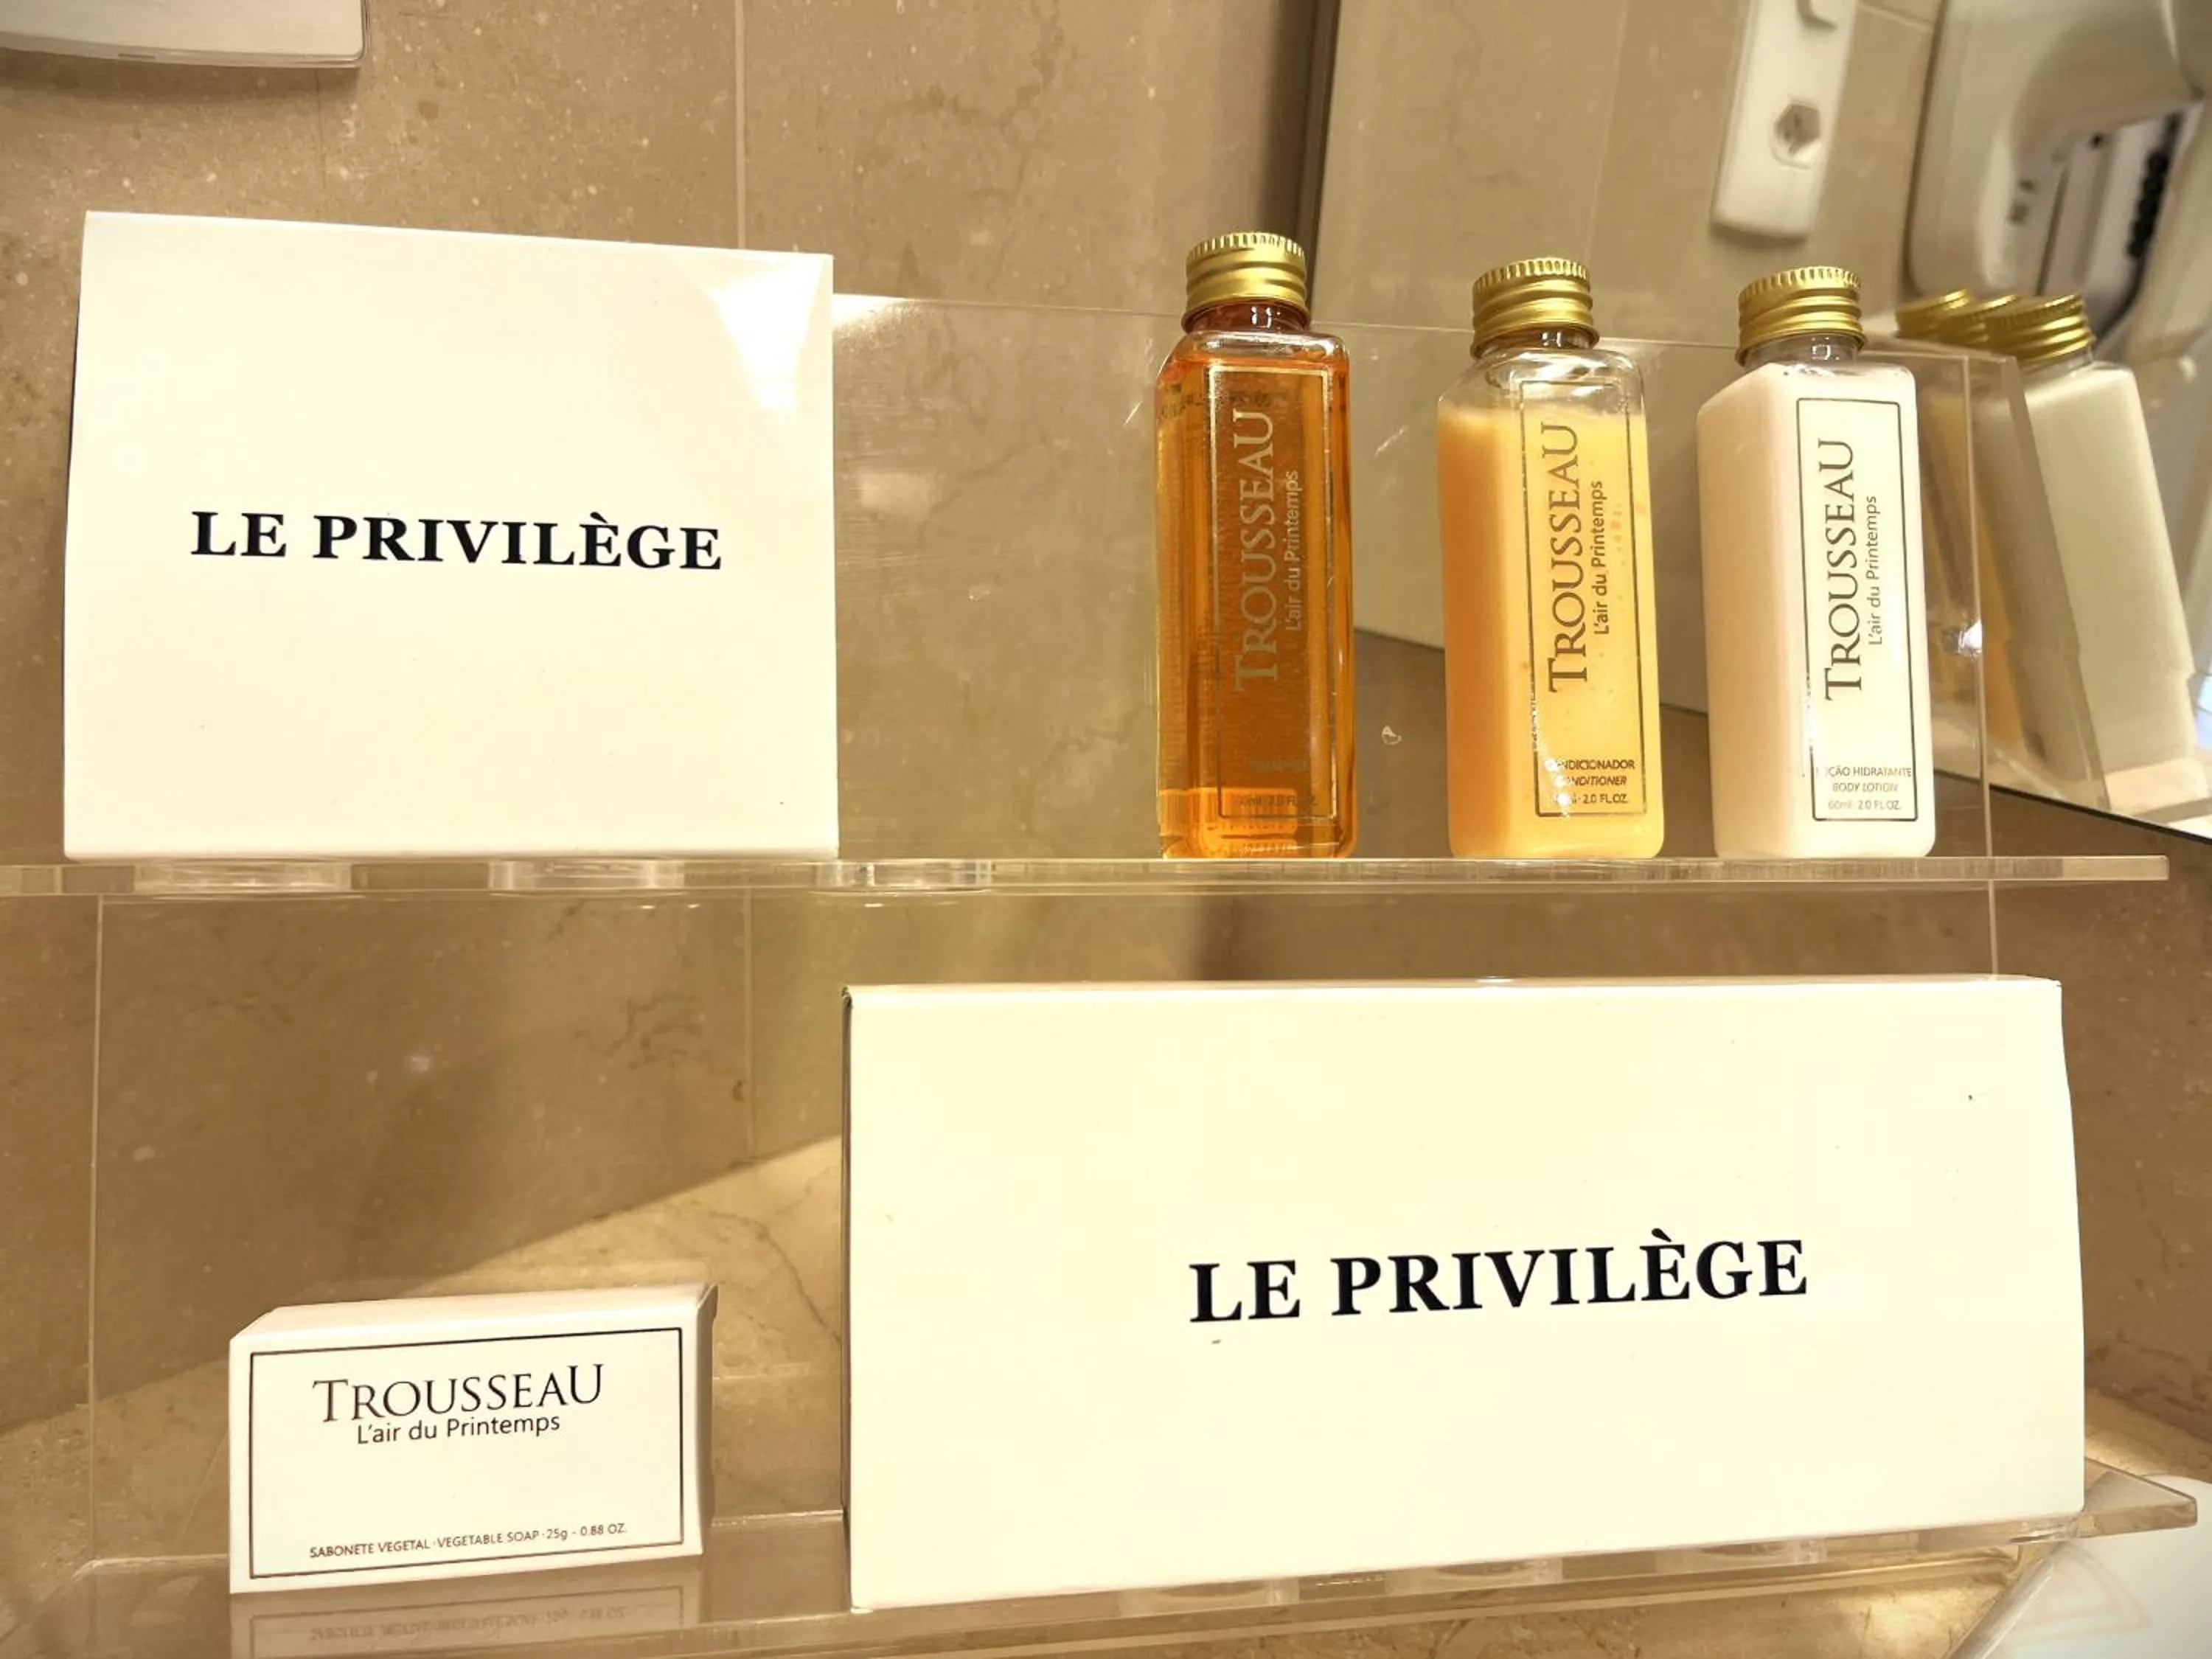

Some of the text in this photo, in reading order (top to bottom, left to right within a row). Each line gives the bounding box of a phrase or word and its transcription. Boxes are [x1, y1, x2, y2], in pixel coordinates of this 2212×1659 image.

[1284, 470, 1304, 562] Printemps
[1590, 480, 1607, 568] Printemps
[1865, 495, 1881, 580] Printemps
[190, 510, 722, 571] LE PRIVILÈGE
[1232, 408, 1279, 692] TROUSSEAU
[1540, 421, 1587, 693] TROUSSEAU
[1284, 567, 1301, 591] du
[1591, 574, 1607, 597] du
[1818, 437, 1863, 701] TROUSSEAU
[1866, 586, 1881, 608] du
[1545, 759, 1635, 771] NDICIONADOR
[1554, 776, 1627, 787] NDITIONER
[1853, 766, 1912, 778] HIDRATANTE
[1832, 782, 1899, 793] BODY LOTION
[1189, 1228, 1808, 1323] LE PRIVILÈGE
[312, 1363, 604, 1423] TROUSSEAU
[408, 1419, 438, 1441] du
[446, 1415, 560, 1437] Printemps
[309, 1543, 375, 1558] SABONETE
[378, 1539, 431, 1553] VEGETAL
[507, 1529, 540, 1543] SOAP
